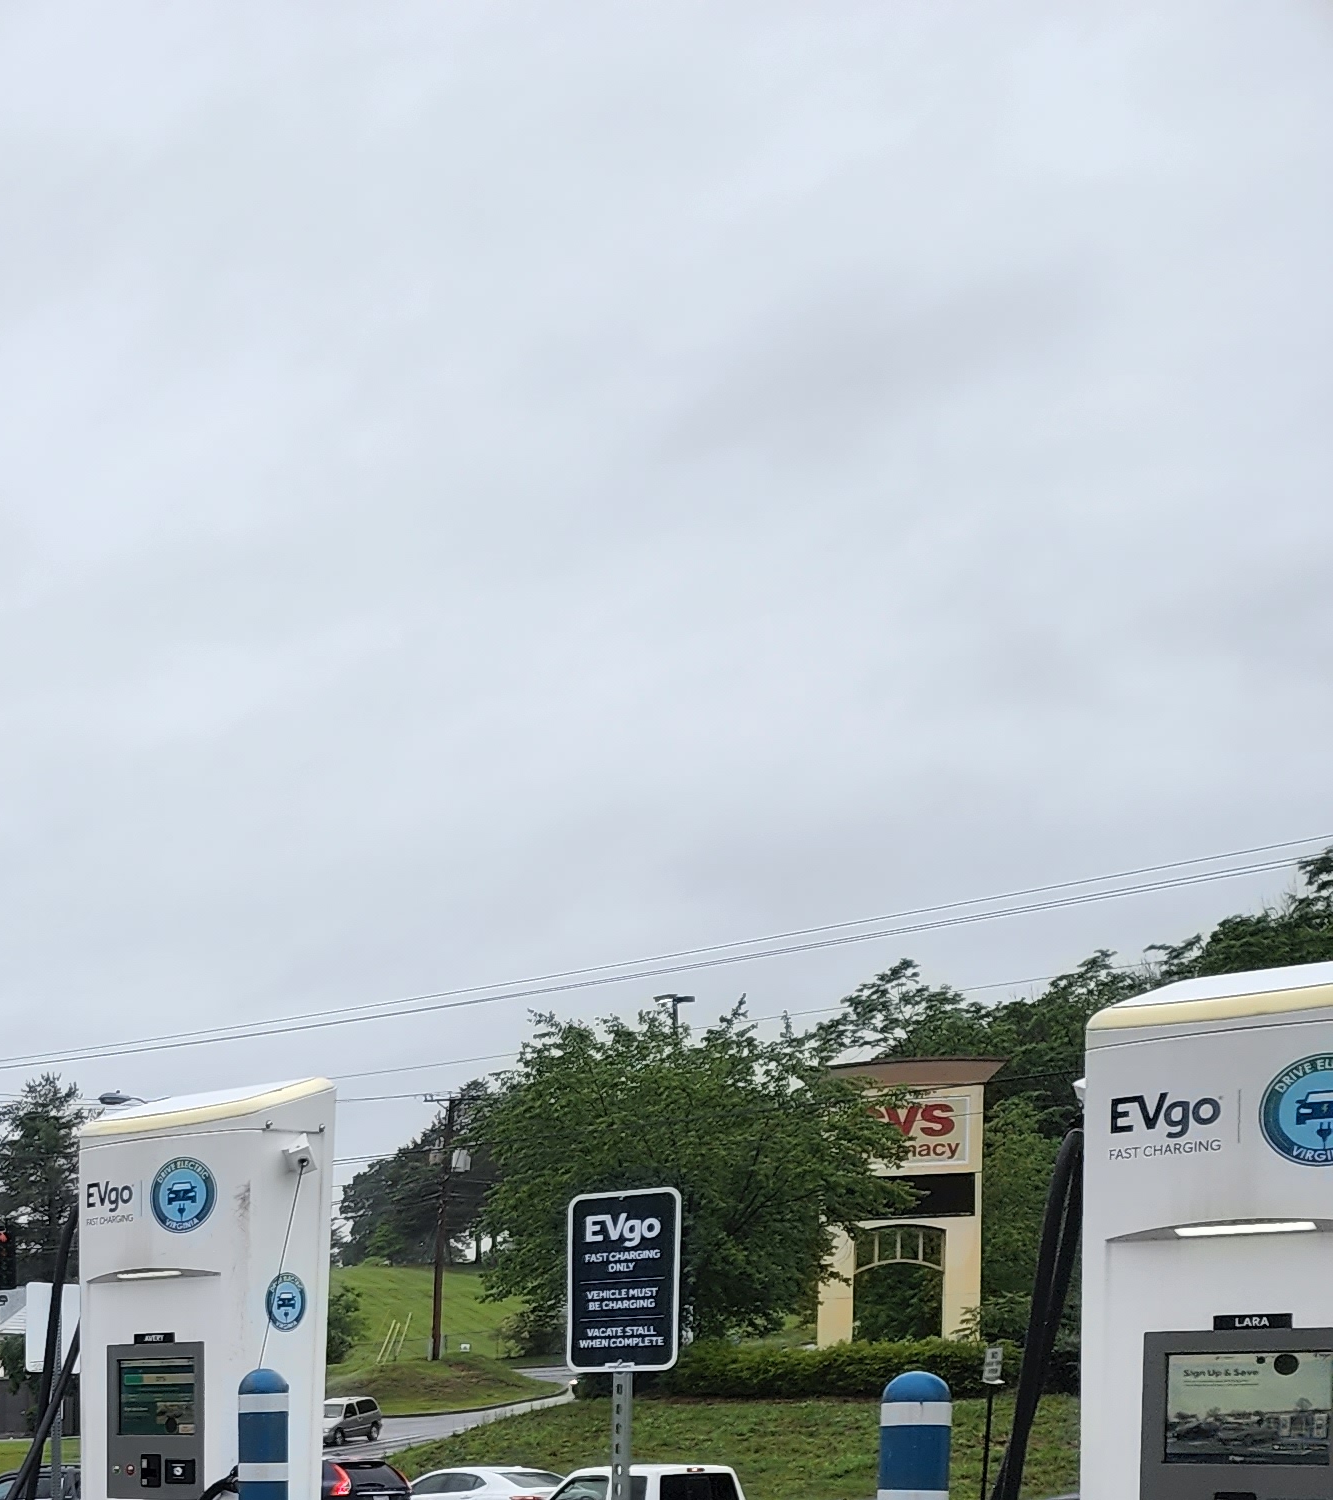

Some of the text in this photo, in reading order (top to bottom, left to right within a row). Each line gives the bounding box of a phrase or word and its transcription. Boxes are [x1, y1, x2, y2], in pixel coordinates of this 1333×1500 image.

[1274, 1063, 1312, 1094] DRIVE
[1110, 1091, 1221, 1138] EVgo
[1109, 1139, 1222, 1160] FAST CHARGING
[1292, 1145, 1333, 1162] VIRGI
[157, 1160, 209, 1183] DRIVE ELECTRIC
[86, 1181, 133, 1213] EVgo
[86, 1213, 134, 1226] FAST CHARGING
[165, 1218, 199, 1229] VIRGINIA
[584, 1213, 661, 1247] EVgo
[584, 1249, 661, 1263] FAST CHARGING
[608, 1262, 635, 1272] ONLY
[586, 1287, 658, 1300] VEHICLE MUST
[588, 1299, 656, 1310] BE CHARGING
[1234, 1316, 1270, 1328] LARA
[587, 1325, 657, 1337] VACATE STALL
[579, 1336, 664, 1349] WHEN COMPLETE
[1183, 1370, 1206, 1379] Sign
[1207, 1369, 1222, 1378] Up
[1233, 1368, 1259, 1377] Save
